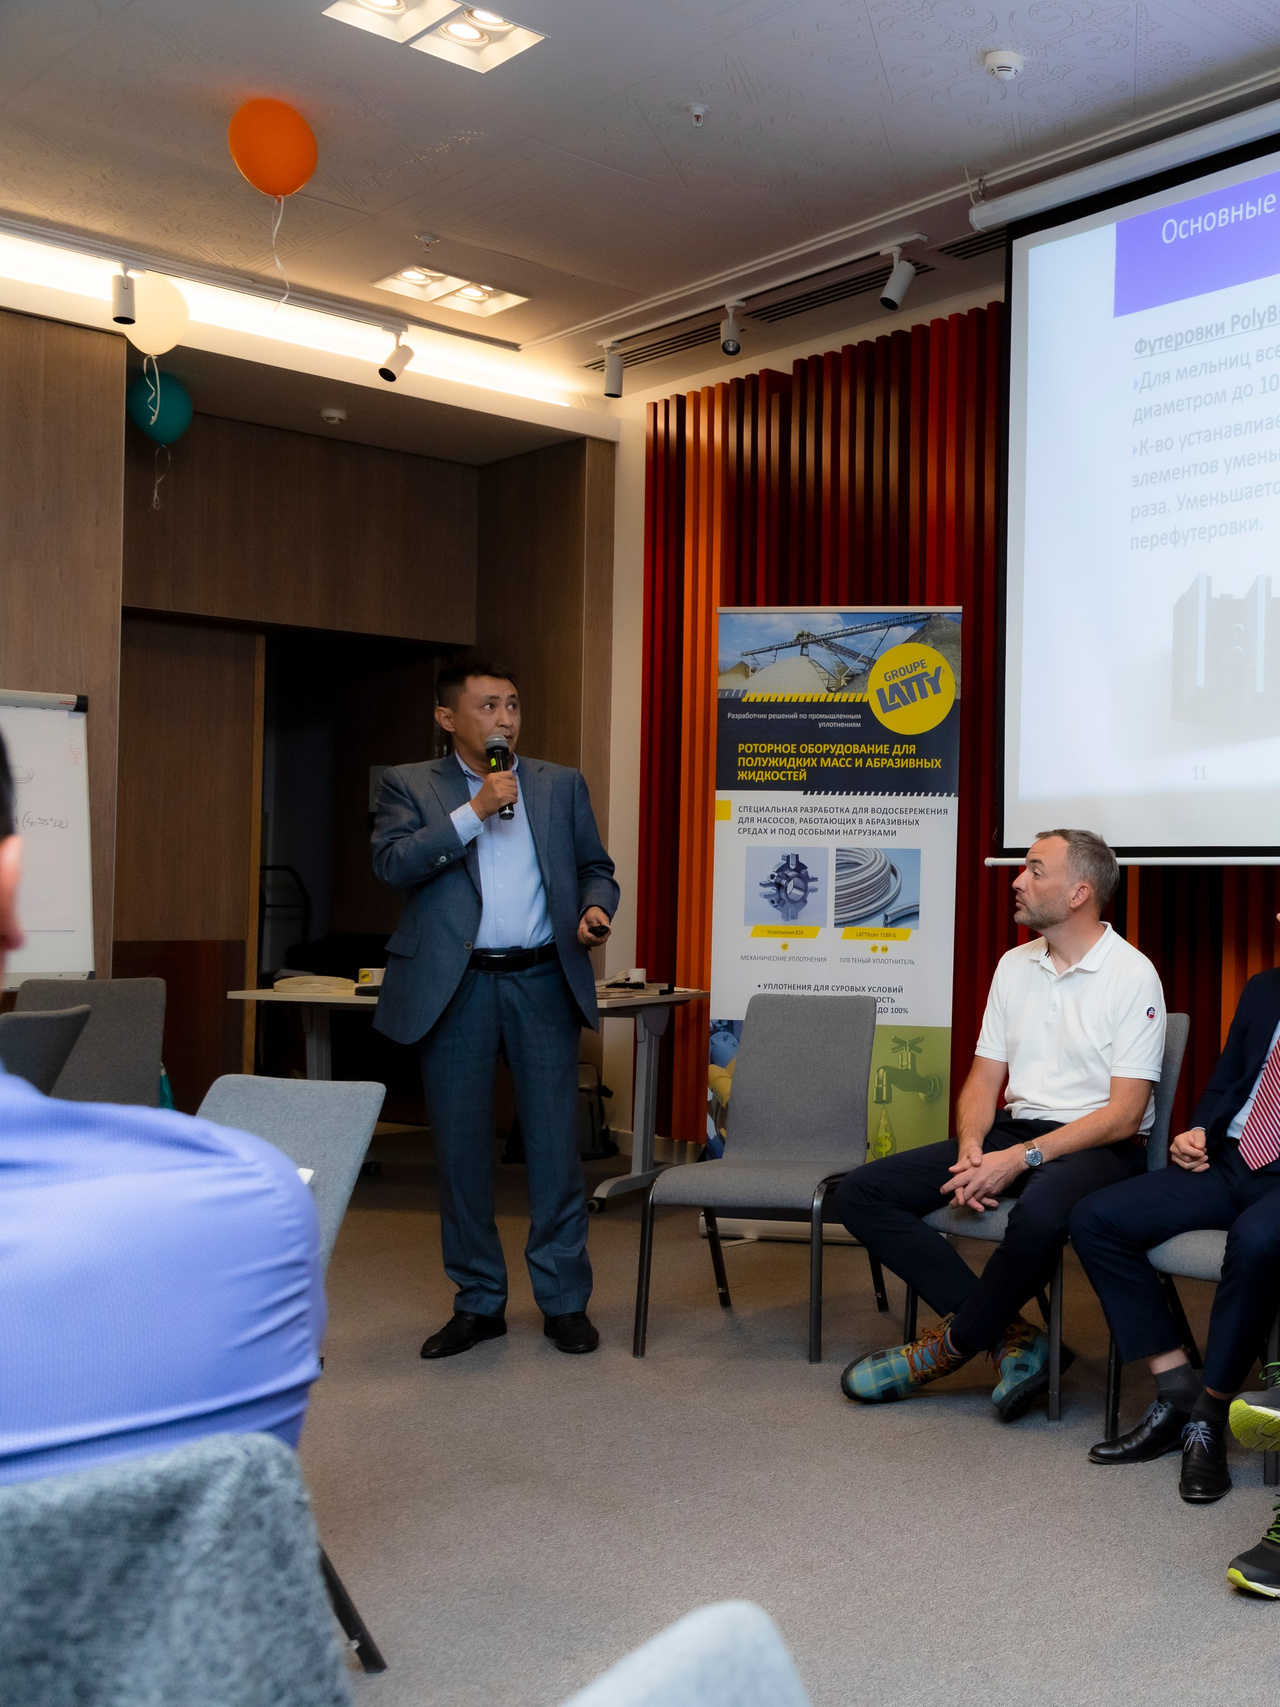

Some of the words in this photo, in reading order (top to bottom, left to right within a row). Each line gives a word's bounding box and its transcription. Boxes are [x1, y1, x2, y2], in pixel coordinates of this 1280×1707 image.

[1162, 193, 1276, 244] Основные
[1134, 320, 1225, 356] Футеровки
[1139, 371, 1171, 393] Для
[1175, 351, 1250, 382] мельниц
[1132, 389, 1227, 426] диаметром
[1231, 384, 1253, 404] до
[1139, 437, 1174, 456] К-во
[1131, 457, 1219, 488] элементов
[1131, 499, 1171, 523] раза.
[1130, 516, 1264, 550] перефутеровки.
[884, 659, 927, 681] GROUPE
[876, 666, 941, 714] LATTY
[728, 712, 767, 720] Разработчик
[768, 712, 798, 720] решений
[738, 743, 797, 754] РОТОРНОЕ
[800, 744, 889, 755] ОБОРУДОВАНИЕ
[892, 744, 916, 755] ДЛЯ
[738, 757, 817, 769] ПОЛУЖИДКИХ
[820, 758, 852, 768] МАСС
[855, 758, 863, 767] И
[866, 758, 942, 768] АБРАЗИВНЫХ
[737, 768, 807, 782] ЖИДКОСТЕЙ
[1192, 766, 1207, 780] 11
[738, 805, 798, 814] СПЕЦИАЛЬНАЯ
[800, 806, 850, 814] РАЗРАБОТКА
[852, 807, 868, 815] ДЛЯ
[871, 807, 948, 816] ВОДОСБЕРЕЖЕНИЯ
[738, 817, 754, 825] ДЛЯ
[757, 817, 797, 826] НАСОСОВ,
[800, 817, 856, 827] РАБОТАЮЩИХ
[866, 818, 919, 826] АБРАЗИВНЫХ
[738, 827, 769, 836] СРЕДАХ
[778, 828, 796, 836] ПОД
[798, 828, 840, 836] ОСОБЫМИ
[843, 829, 897, 837] НАГРУЗКАМИ
[763, 983, 811, 991] УПЛОТНЕНИЯ
[868, 985, 903, 993] УСЛОВИЙ
